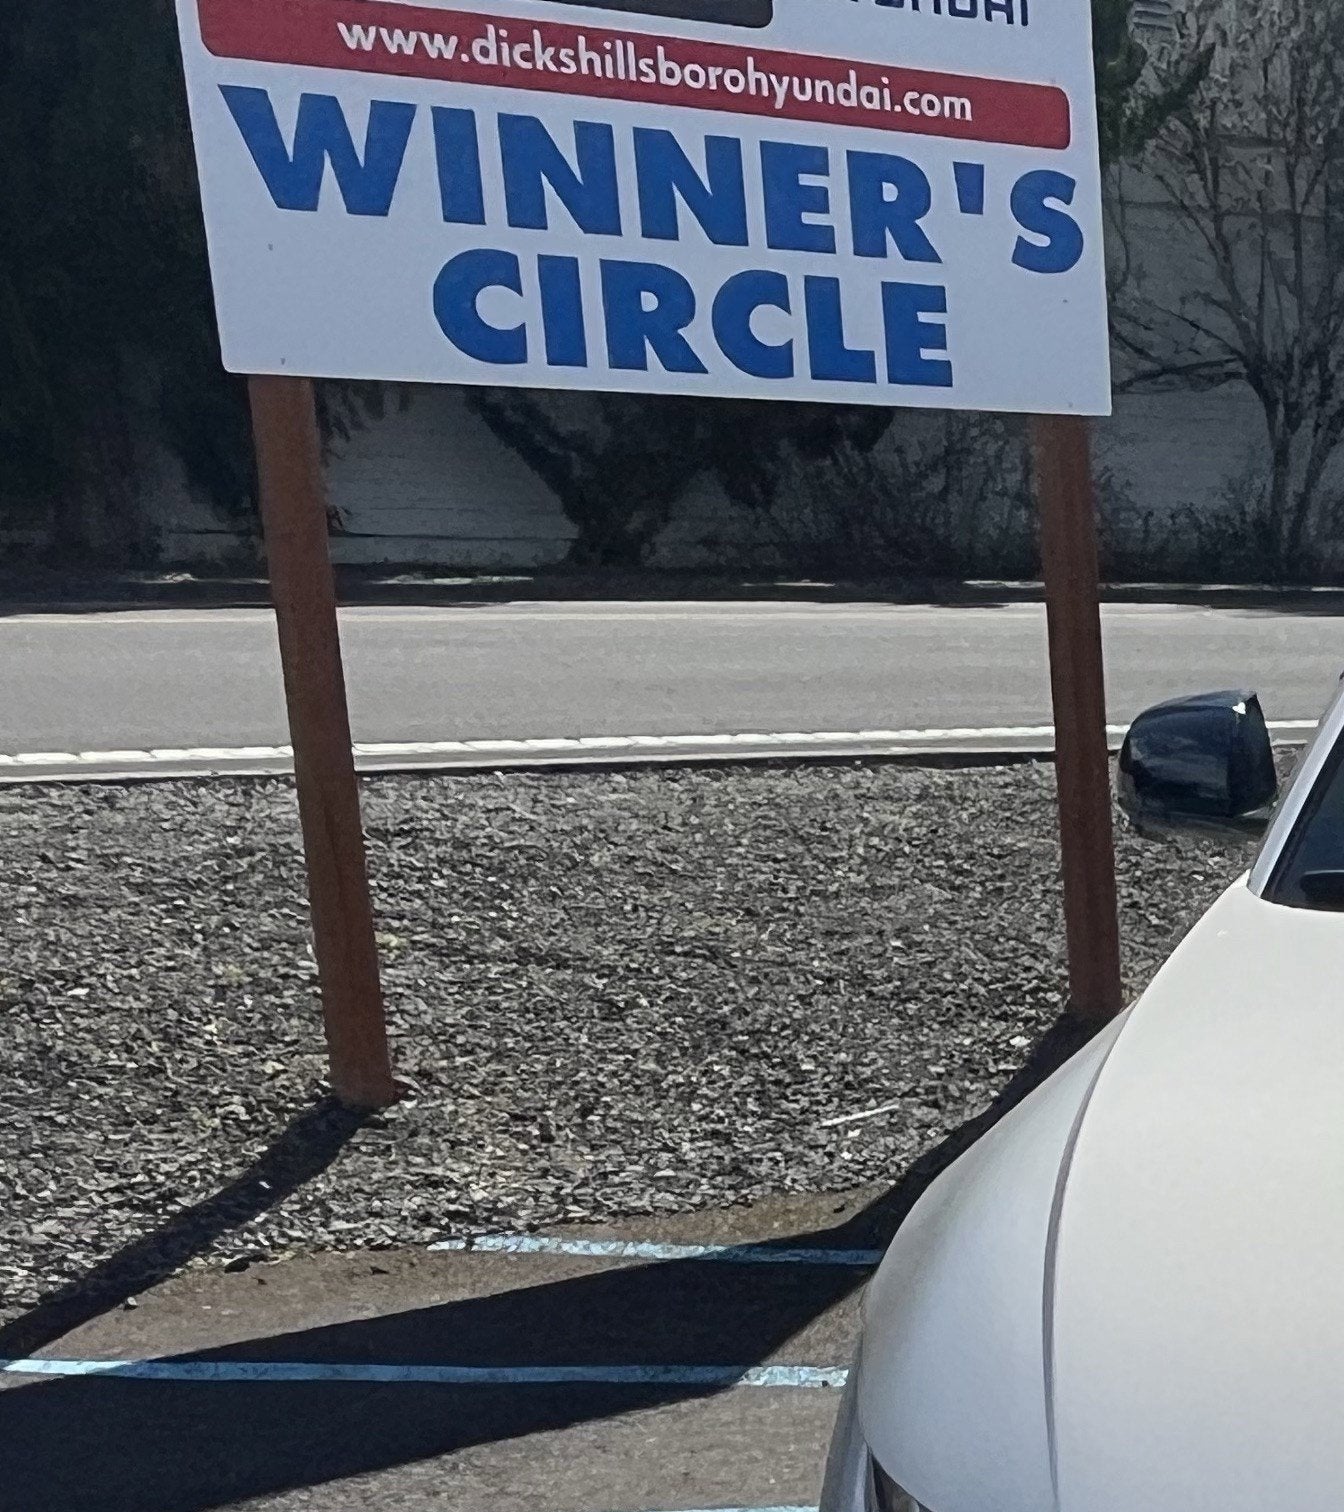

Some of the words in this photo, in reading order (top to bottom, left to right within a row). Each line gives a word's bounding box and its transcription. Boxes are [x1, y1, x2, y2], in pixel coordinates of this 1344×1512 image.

[338, 15, 973, 123] www.dickshillsborohyundai.com
[219, 85, 1085, 274] WINNER'S
[433, 249, 953, 387] CIRCLE
